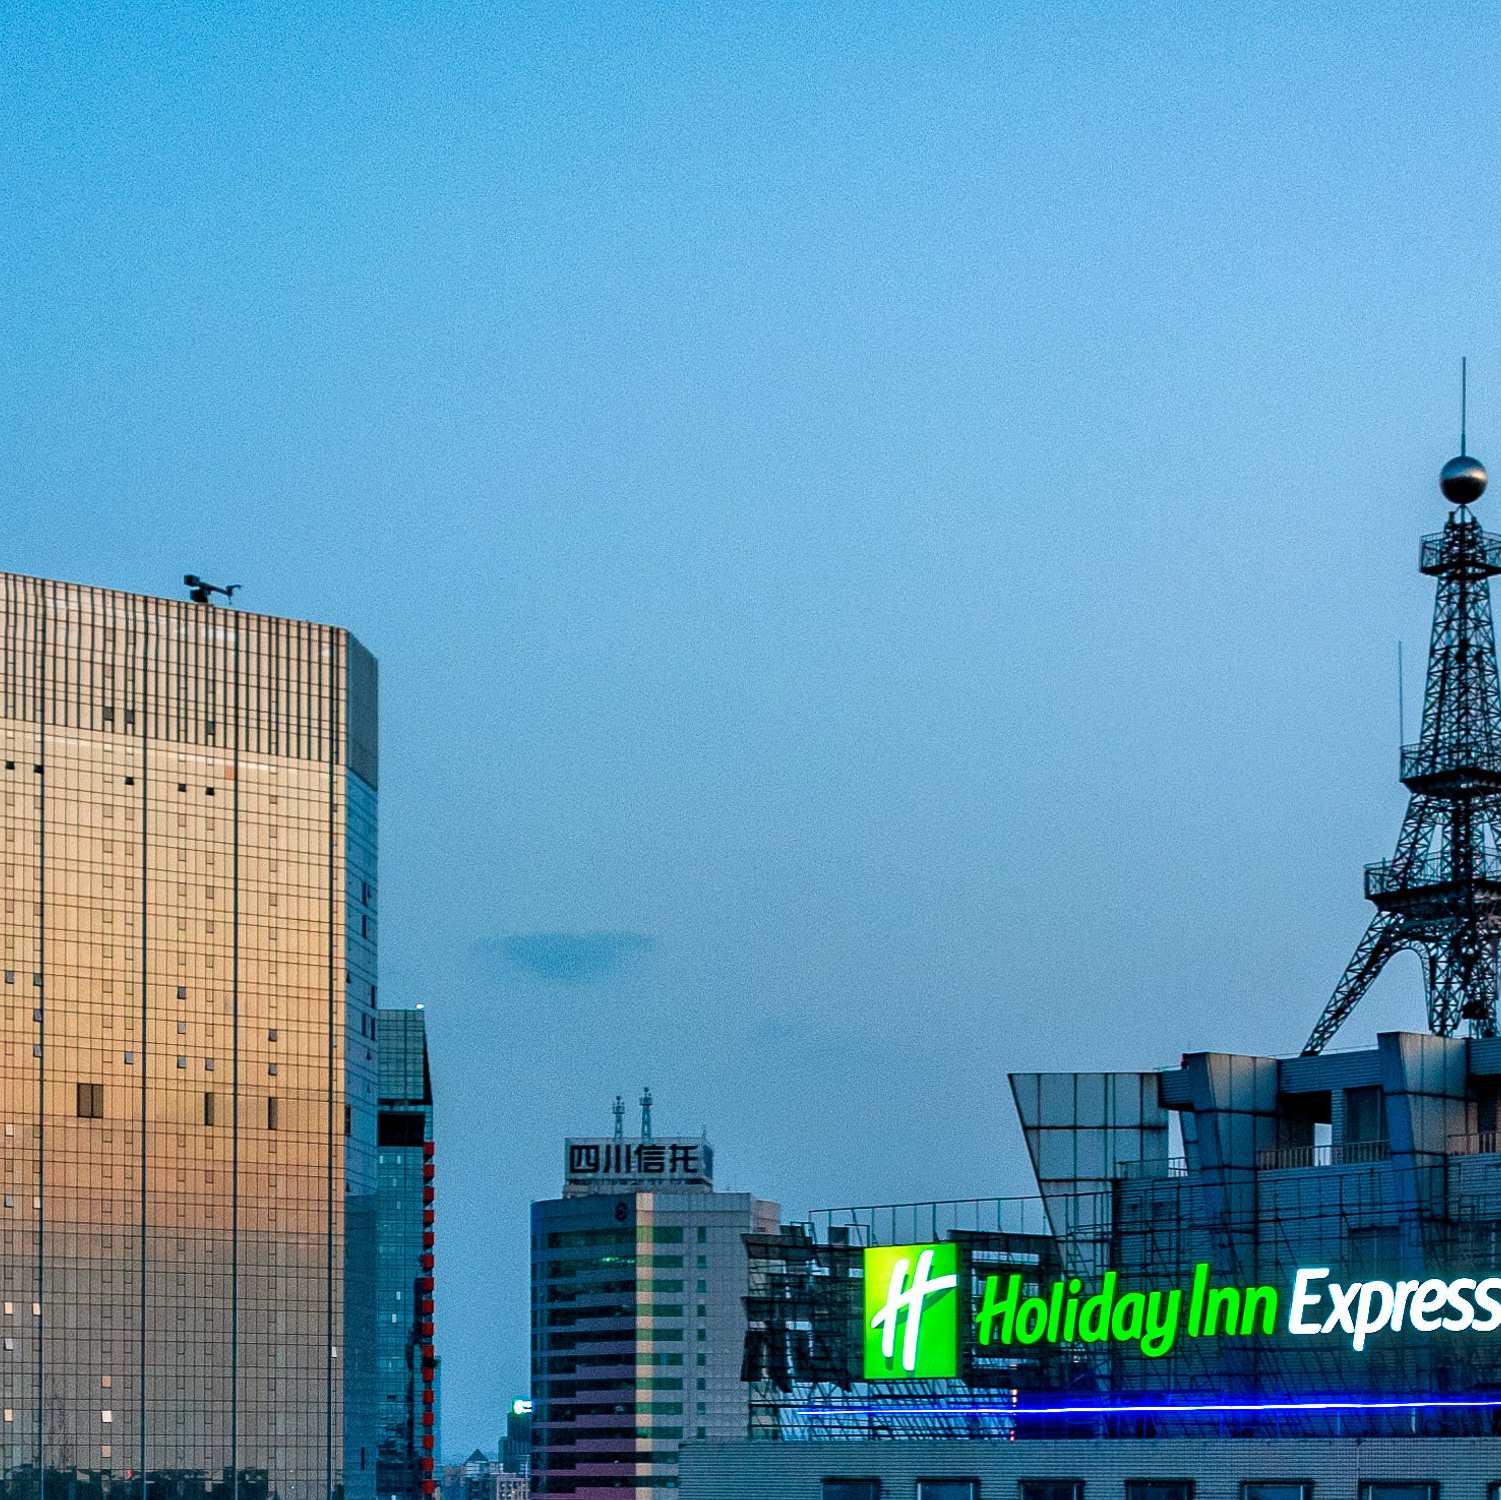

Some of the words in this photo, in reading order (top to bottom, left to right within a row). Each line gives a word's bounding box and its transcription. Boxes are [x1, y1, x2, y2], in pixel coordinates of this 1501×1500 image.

[569, 1143, 699, 1174] 四川信托
[975, 1271, 1182, 1357] Holiday
[1187, 1263, 1278, 1338] Inn
